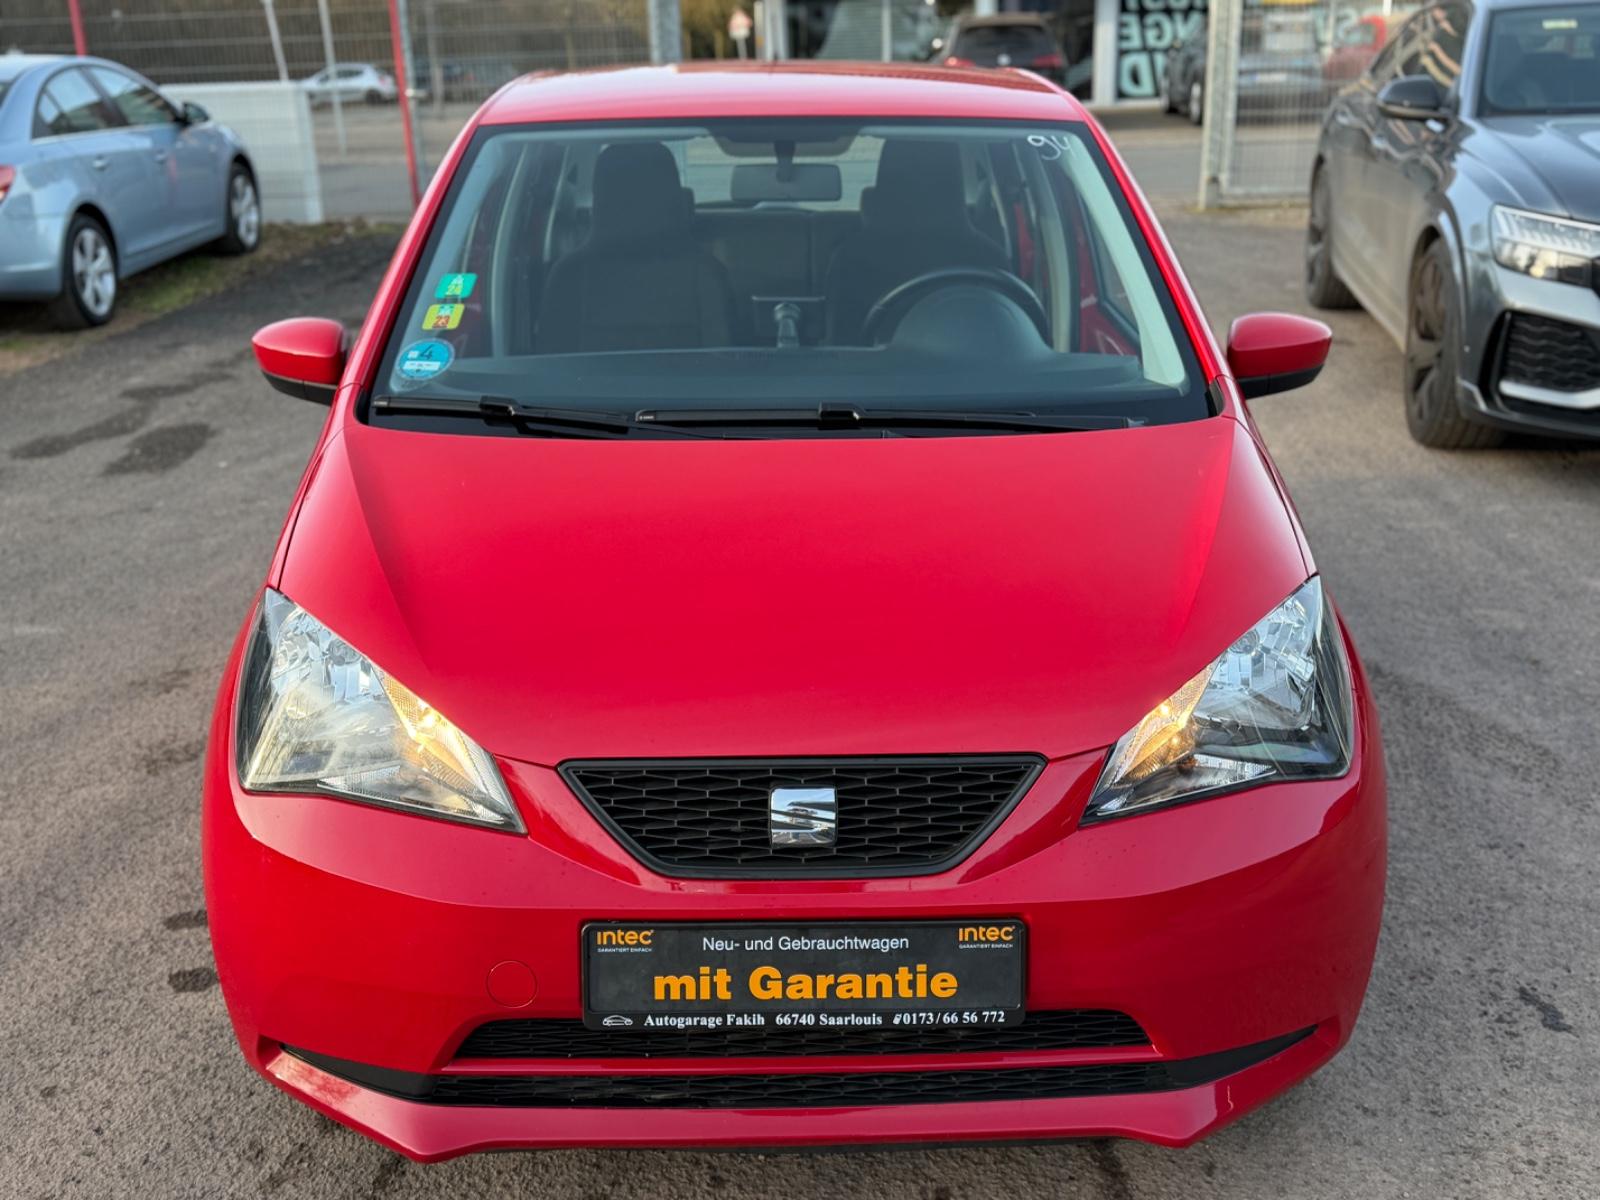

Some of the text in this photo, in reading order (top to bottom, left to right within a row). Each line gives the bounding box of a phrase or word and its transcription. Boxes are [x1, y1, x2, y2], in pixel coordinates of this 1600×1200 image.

[432, 315, 451, 328] 23
[420, 343, 434, 360] 4
[596, 929, 653, 945] intec
[958, 926, 1014, 942] intec
[702, 936, 910, 953] Neu- und Gebrauchtwagen
[654, 964, 958, 1000] mit Garantie
[643, 1015, 723, 1029] Autogarage
[726, 1013, 765, 1026] Fakih
[775, 1014, 815, 1026] 66740
[819, 1013, 883, 1026] Saarlouis
[962, 1012, 978, 1024] 56
[982, 1011, 1006, 1024] 772
